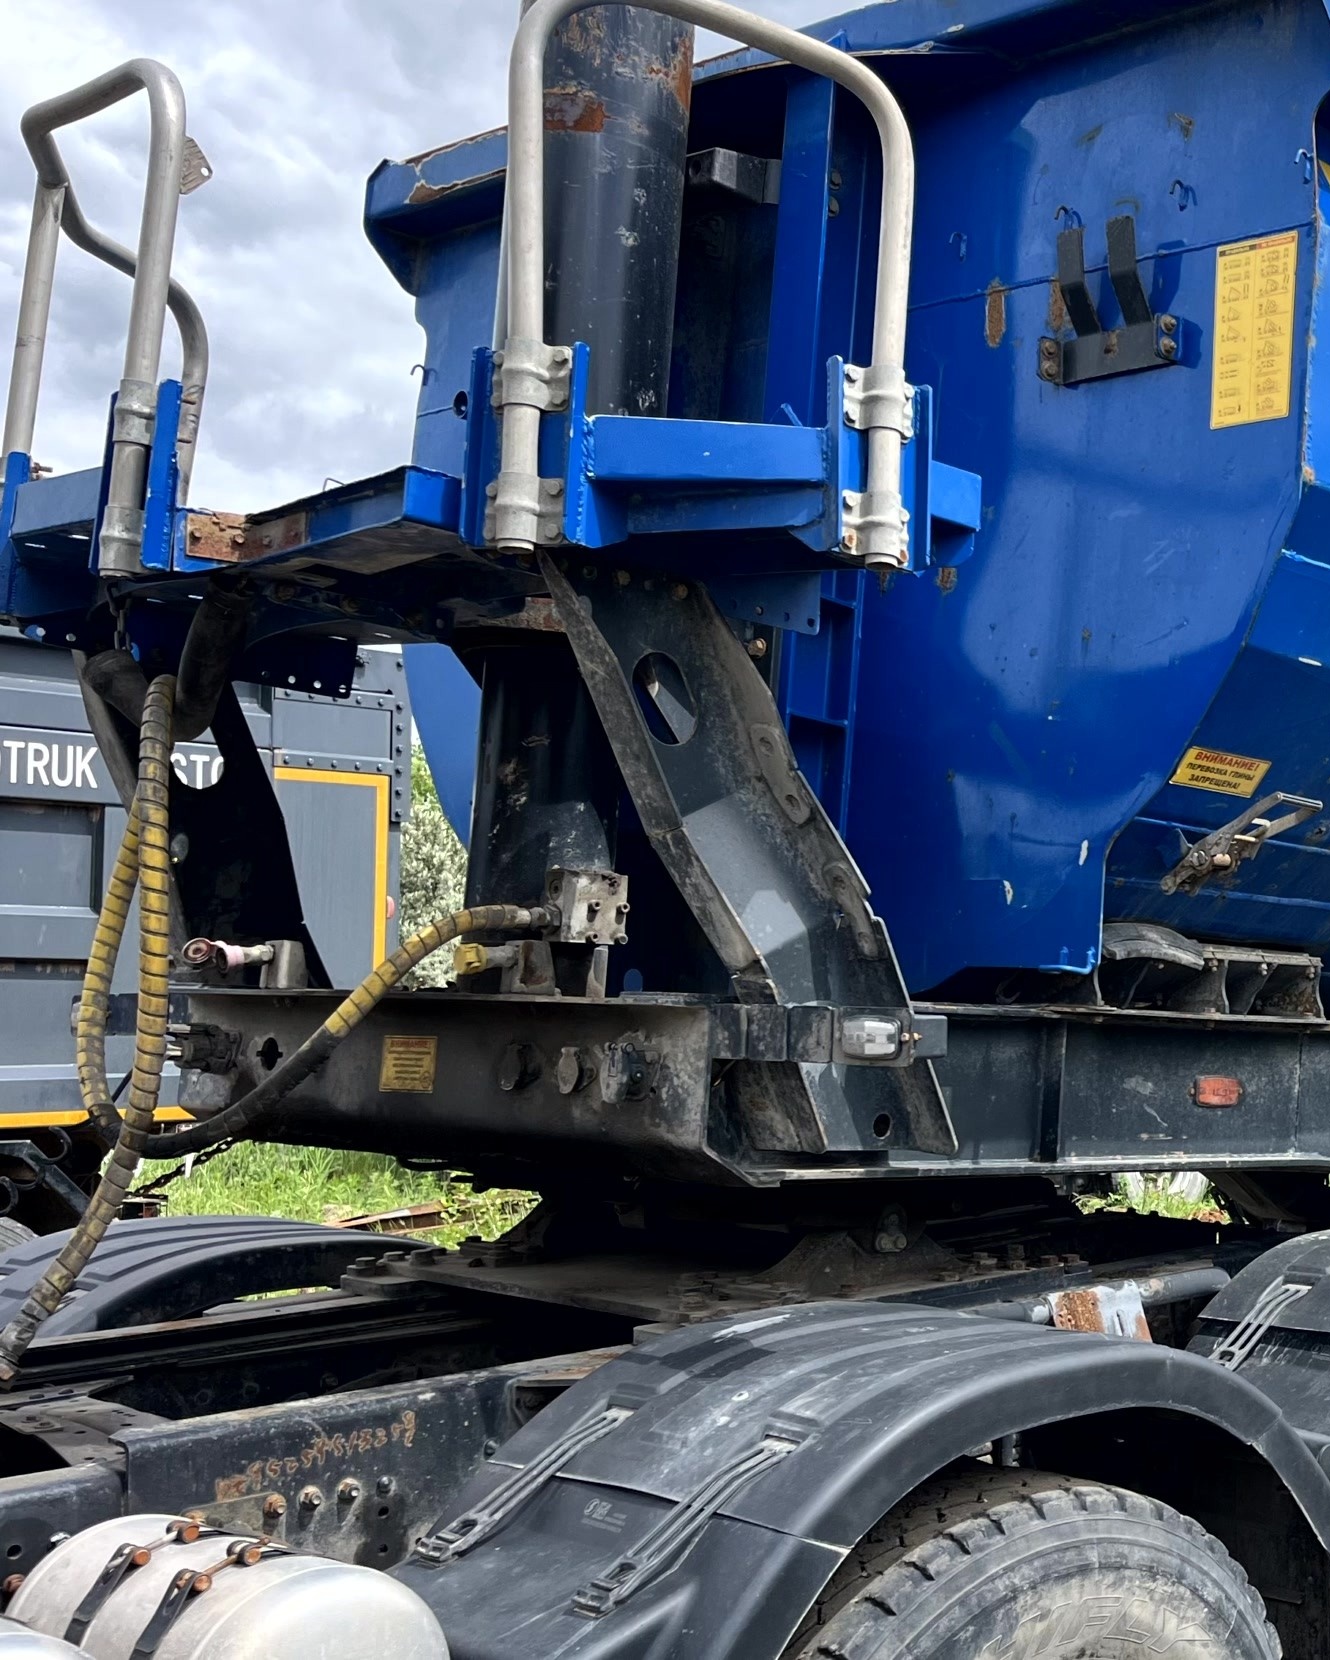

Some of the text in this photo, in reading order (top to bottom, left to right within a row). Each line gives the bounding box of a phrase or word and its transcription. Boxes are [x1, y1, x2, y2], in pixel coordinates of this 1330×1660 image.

[0, 740, 98, 789] TRUK
[1186, 762, 1228, 776] ПЕРЕВОЗКА
[1194, 751, 1260, 772] ВНИМАНИЕ!
[1188, 773, 1241, 790] ЗАПРЕЩЕНА!
